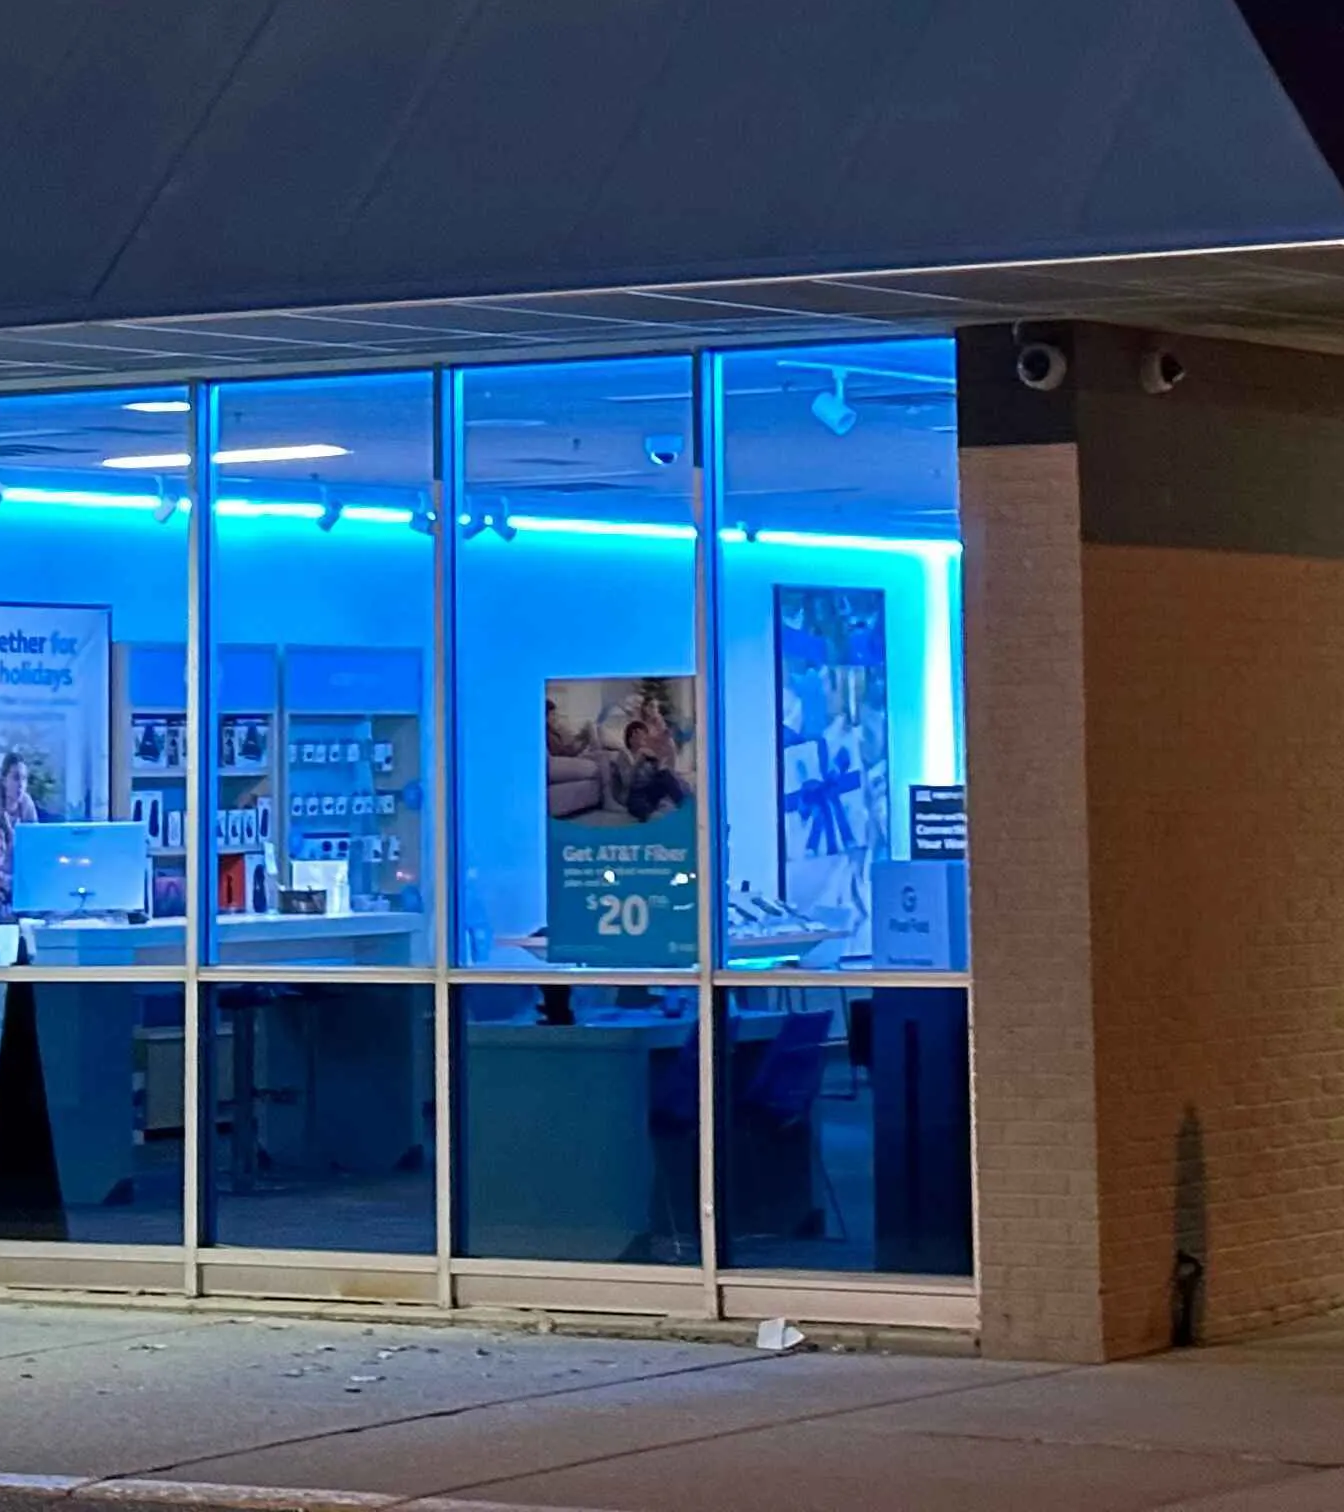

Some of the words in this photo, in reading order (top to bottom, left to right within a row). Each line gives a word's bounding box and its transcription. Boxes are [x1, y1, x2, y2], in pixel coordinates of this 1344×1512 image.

[563, 844, 593, 862] Get
[596, 844, 641, 862] AT&T
[644, 843, 688, 862] Fiber
[585, 893, 650, 936] $20
